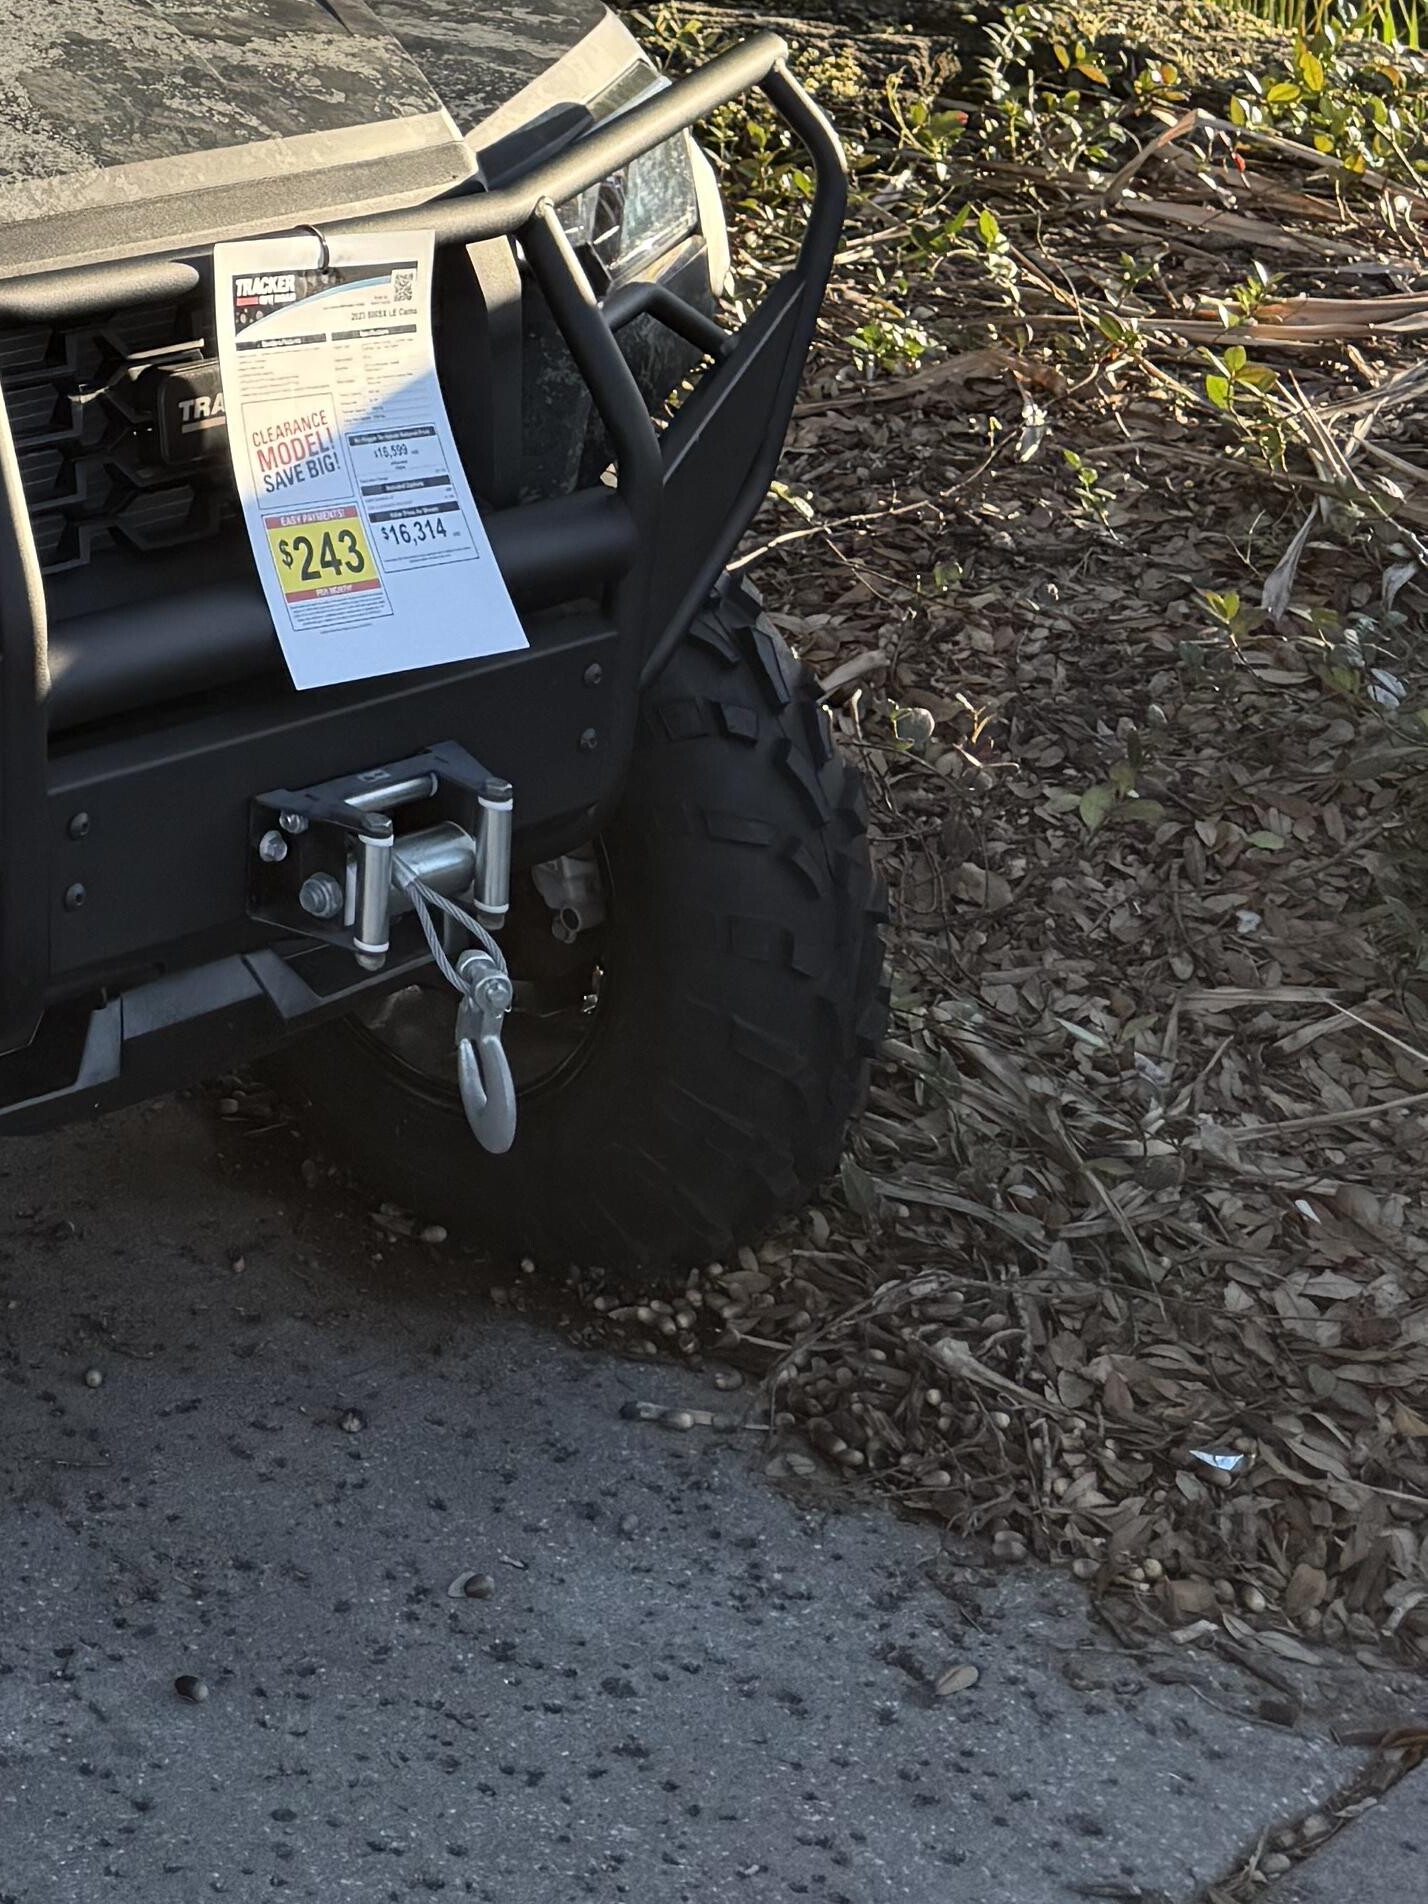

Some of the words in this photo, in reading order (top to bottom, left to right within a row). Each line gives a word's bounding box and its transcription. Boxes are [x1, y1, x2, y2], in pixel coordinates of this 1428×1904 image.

[235, 274, 295, 297] TRACKER
[252, 409, 328, 448] CLEARANCE
[256, 427, 335, 473] MODEL!
[263, 463, 306, 493] SAVE
[305, 451, 341, 479] BIG!
[280, 514, 301, 526] EASY
[381, 517, 447, 546] $16,314
[278, 529, 365, 581] $243
